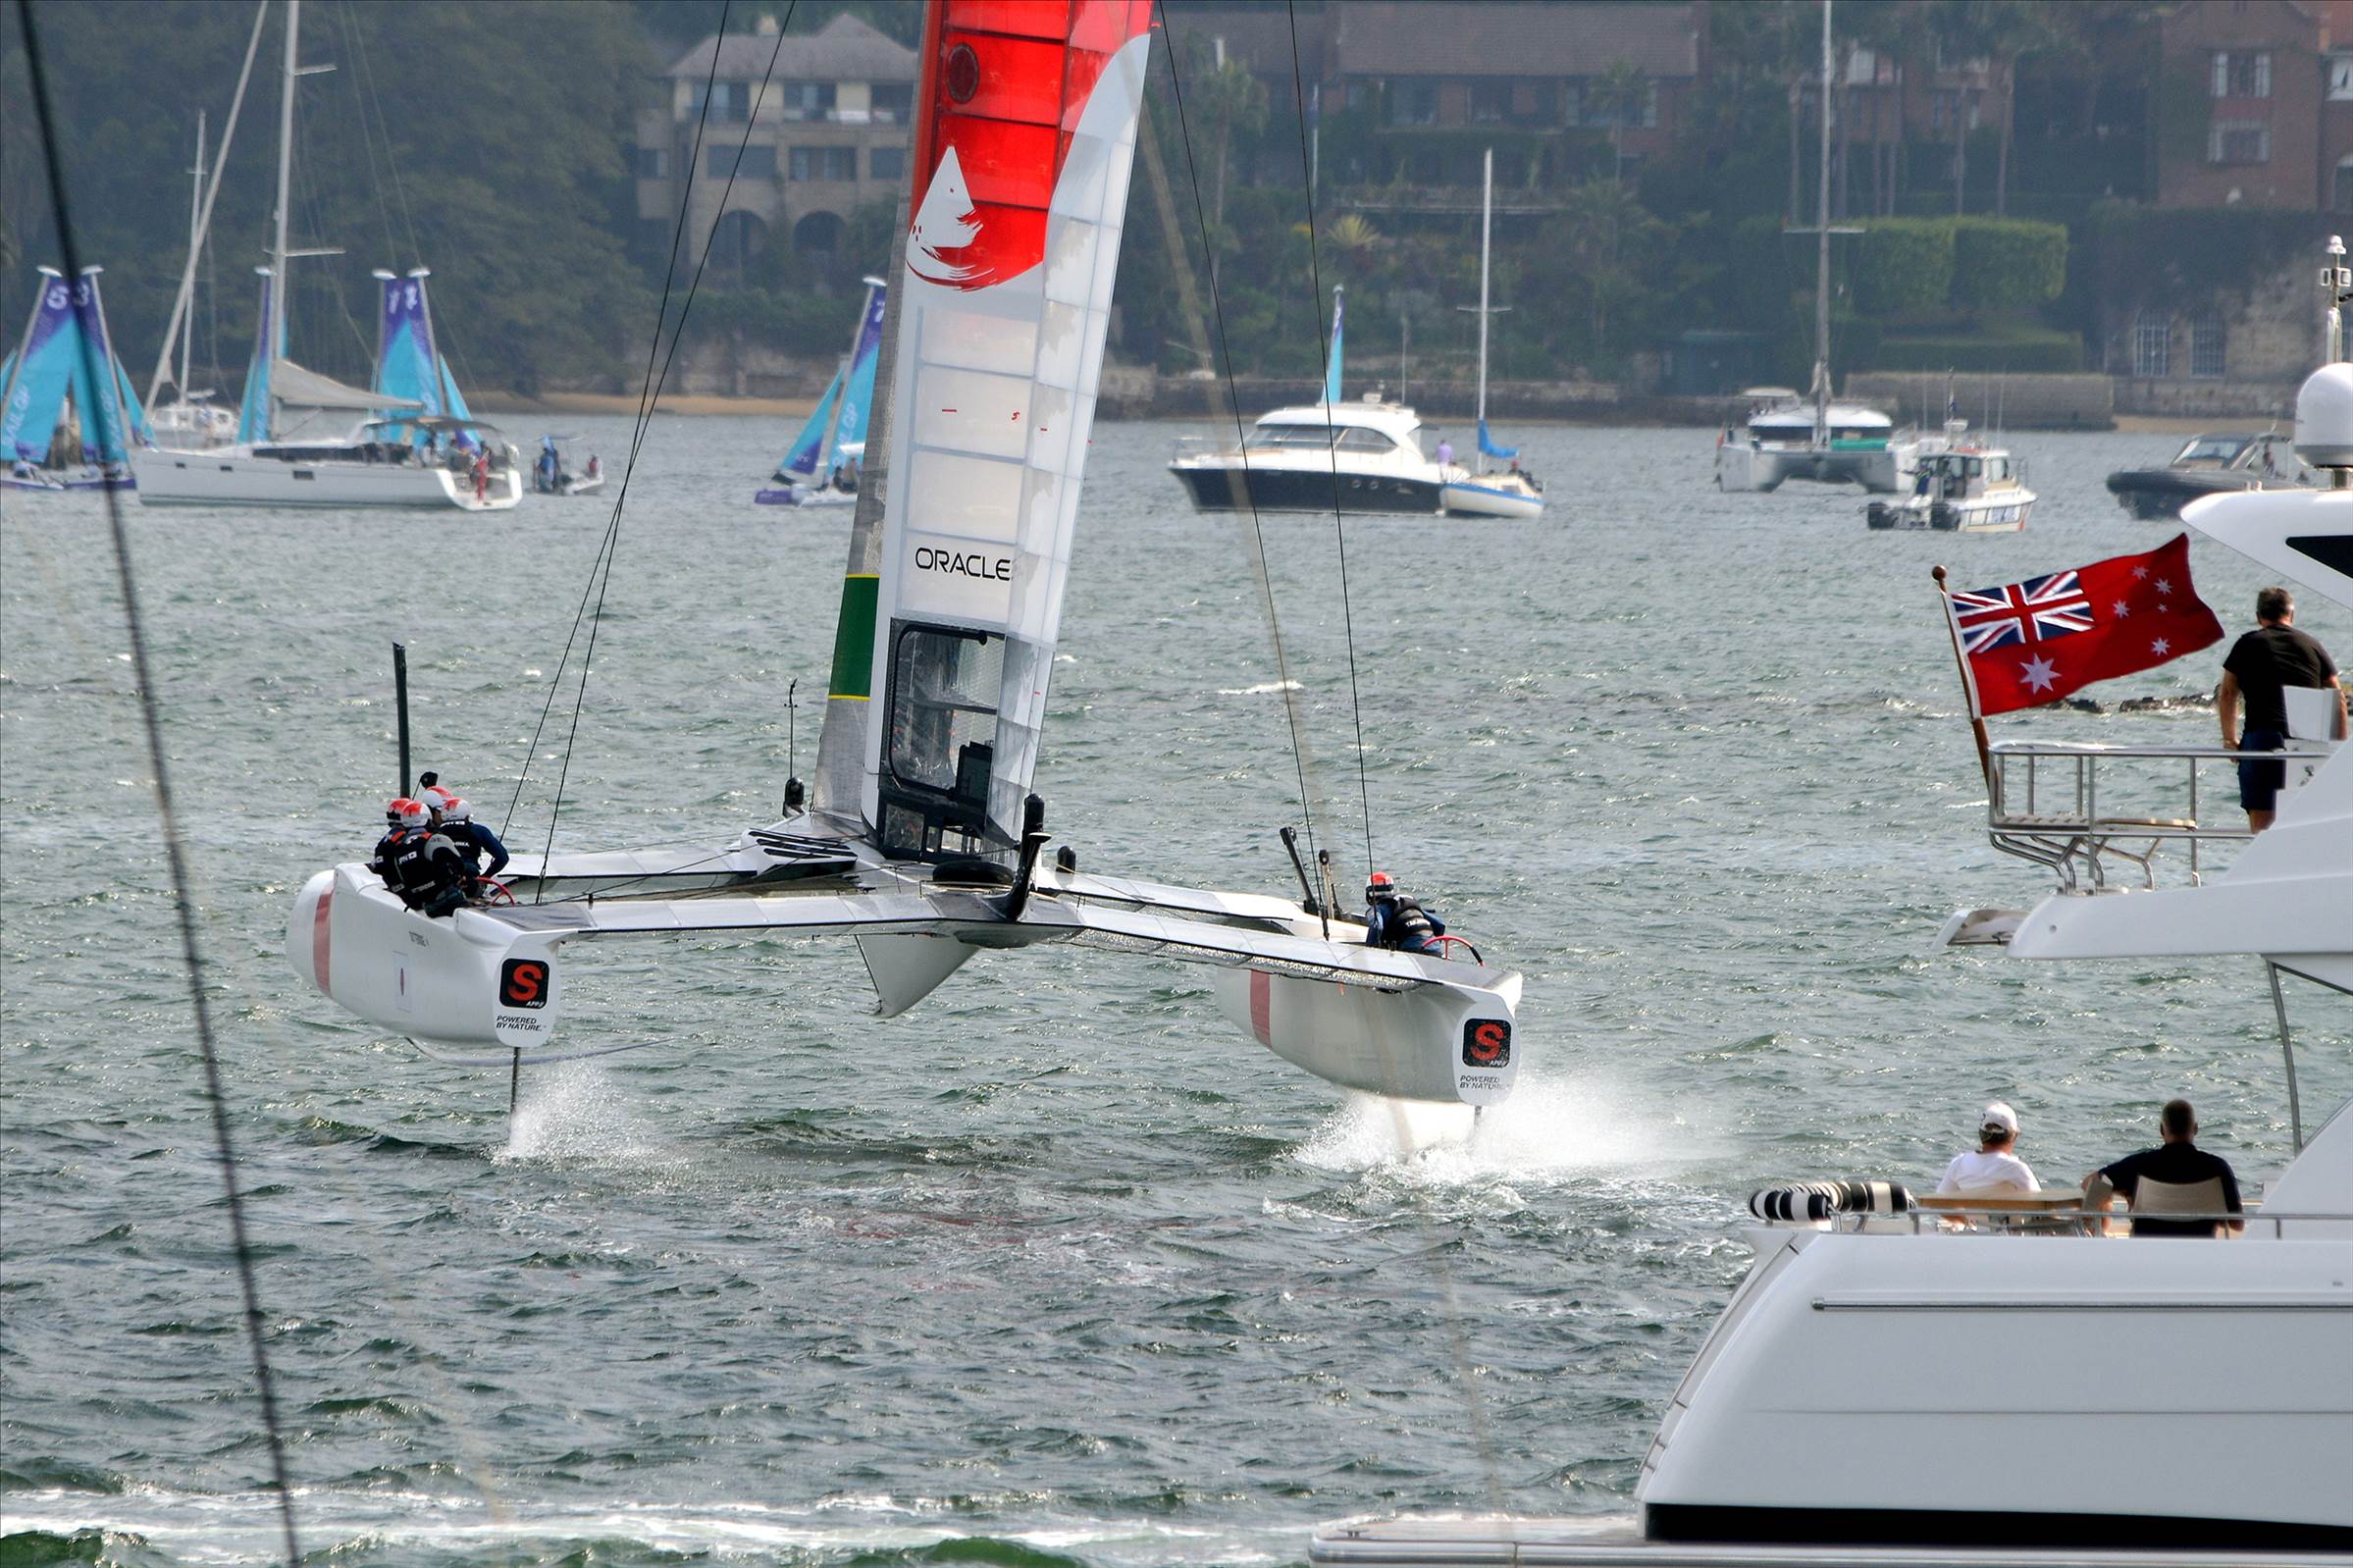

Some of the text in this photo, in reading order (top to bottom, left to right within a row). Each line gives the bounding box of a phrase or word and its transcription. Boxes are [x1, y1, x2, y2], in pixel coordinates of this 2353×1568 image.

[915, 547, 1012, 581] ORACLE
[507, 964, 543, 1002] S
[497, 1016, 537, 1024] POWERED
[1470, 1022, 1505, 1061] S
[1459, 1074, 1500, 1084] POWERED
[1472, 1082, 1506, 1091] NATU
